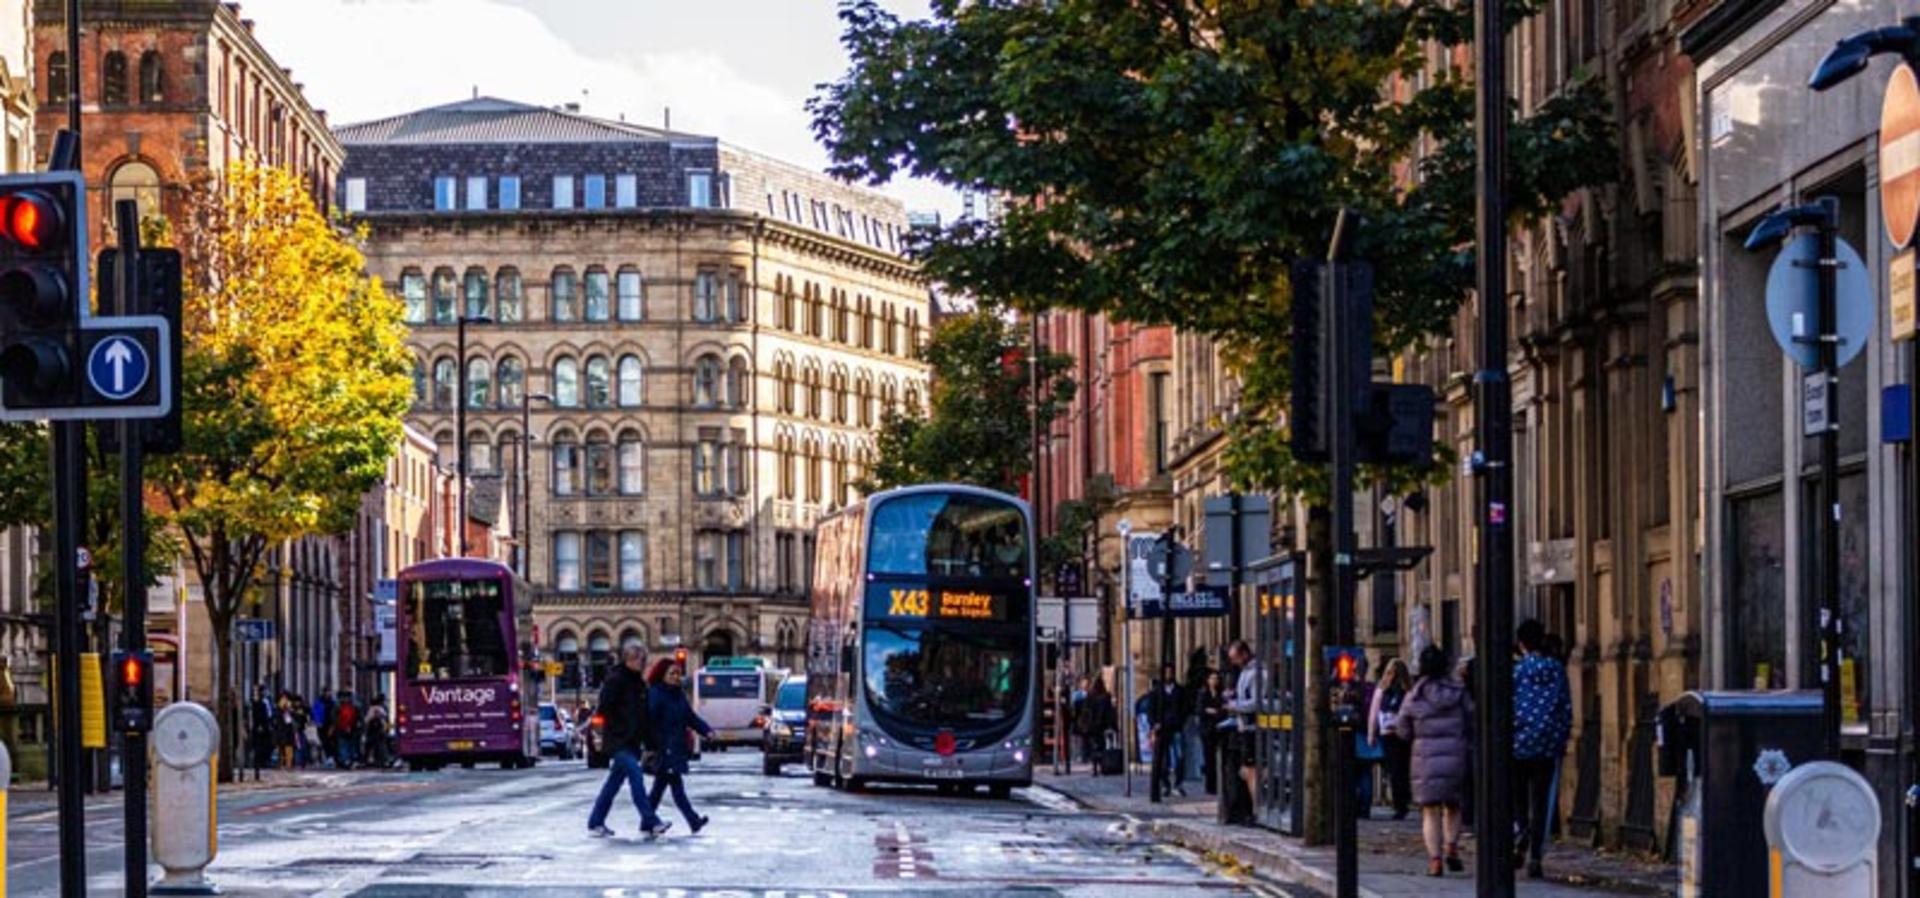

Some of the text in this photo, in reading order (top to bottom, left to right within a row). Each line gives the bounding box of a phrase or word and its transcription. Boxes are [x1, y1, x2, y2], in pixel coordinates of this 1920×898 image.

[889, 590, 928, 616] X43
[942, 591, 991, 608] Burnley
[421, 686, 496, 707] Vantage
